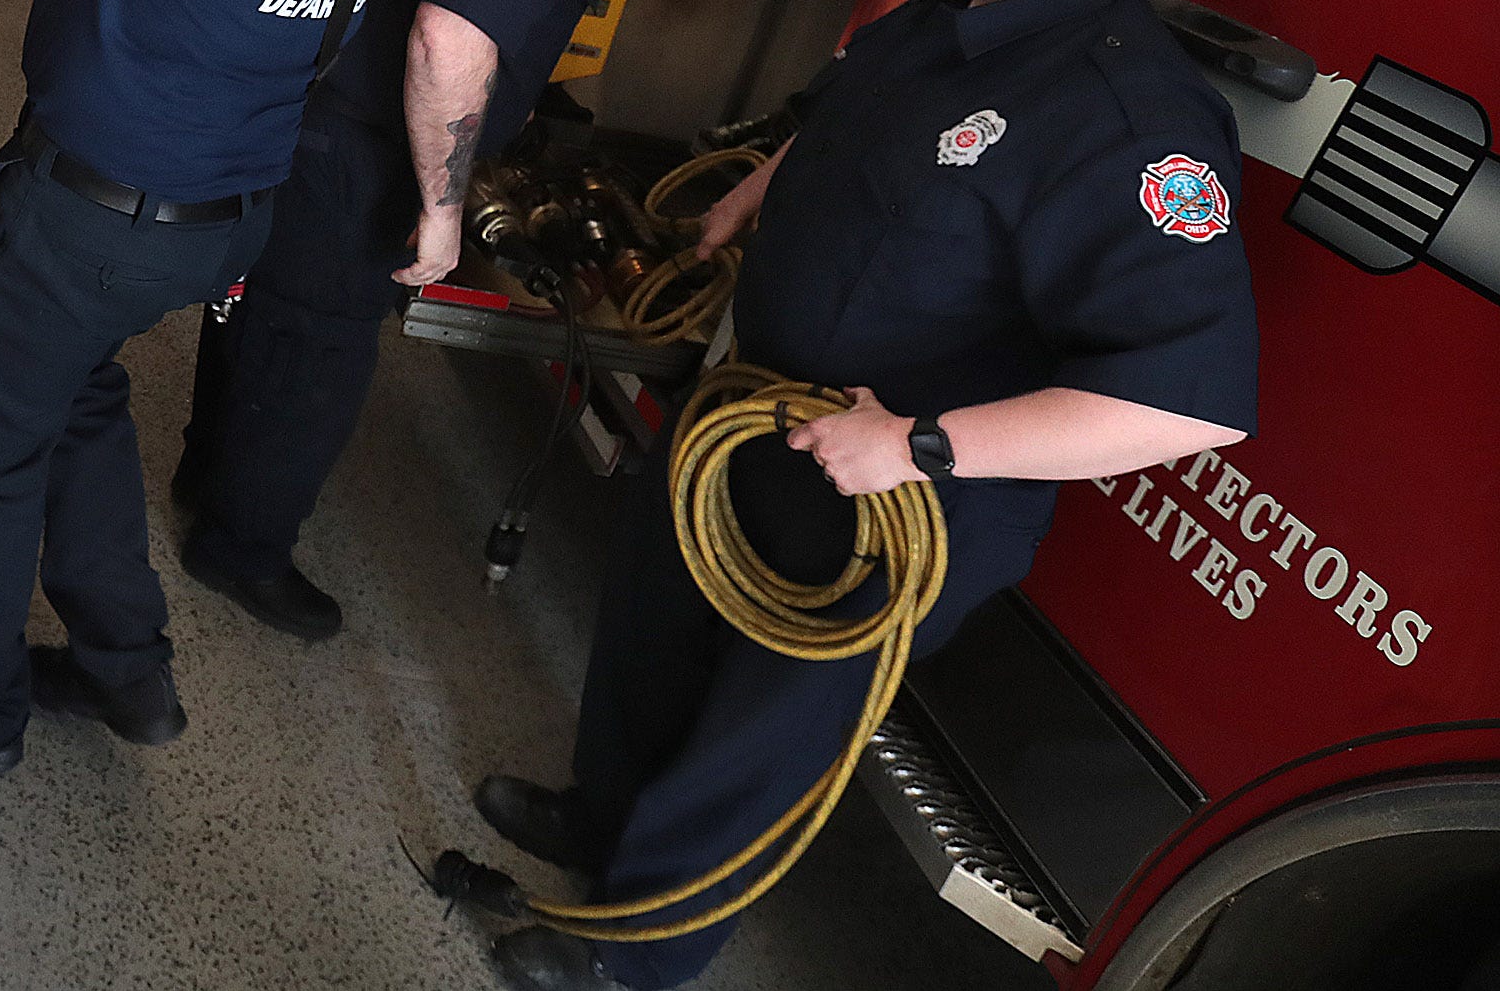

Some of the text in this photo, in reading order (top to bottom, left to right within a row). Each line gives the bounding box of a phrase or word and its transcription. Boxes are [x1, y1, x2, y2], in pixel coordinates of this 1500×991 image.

[1184, 224, 1211, 234] OHIO
[1121, 473, 1268, 620] LIVES
[1162, 448, 1433, 667] TECTORS
